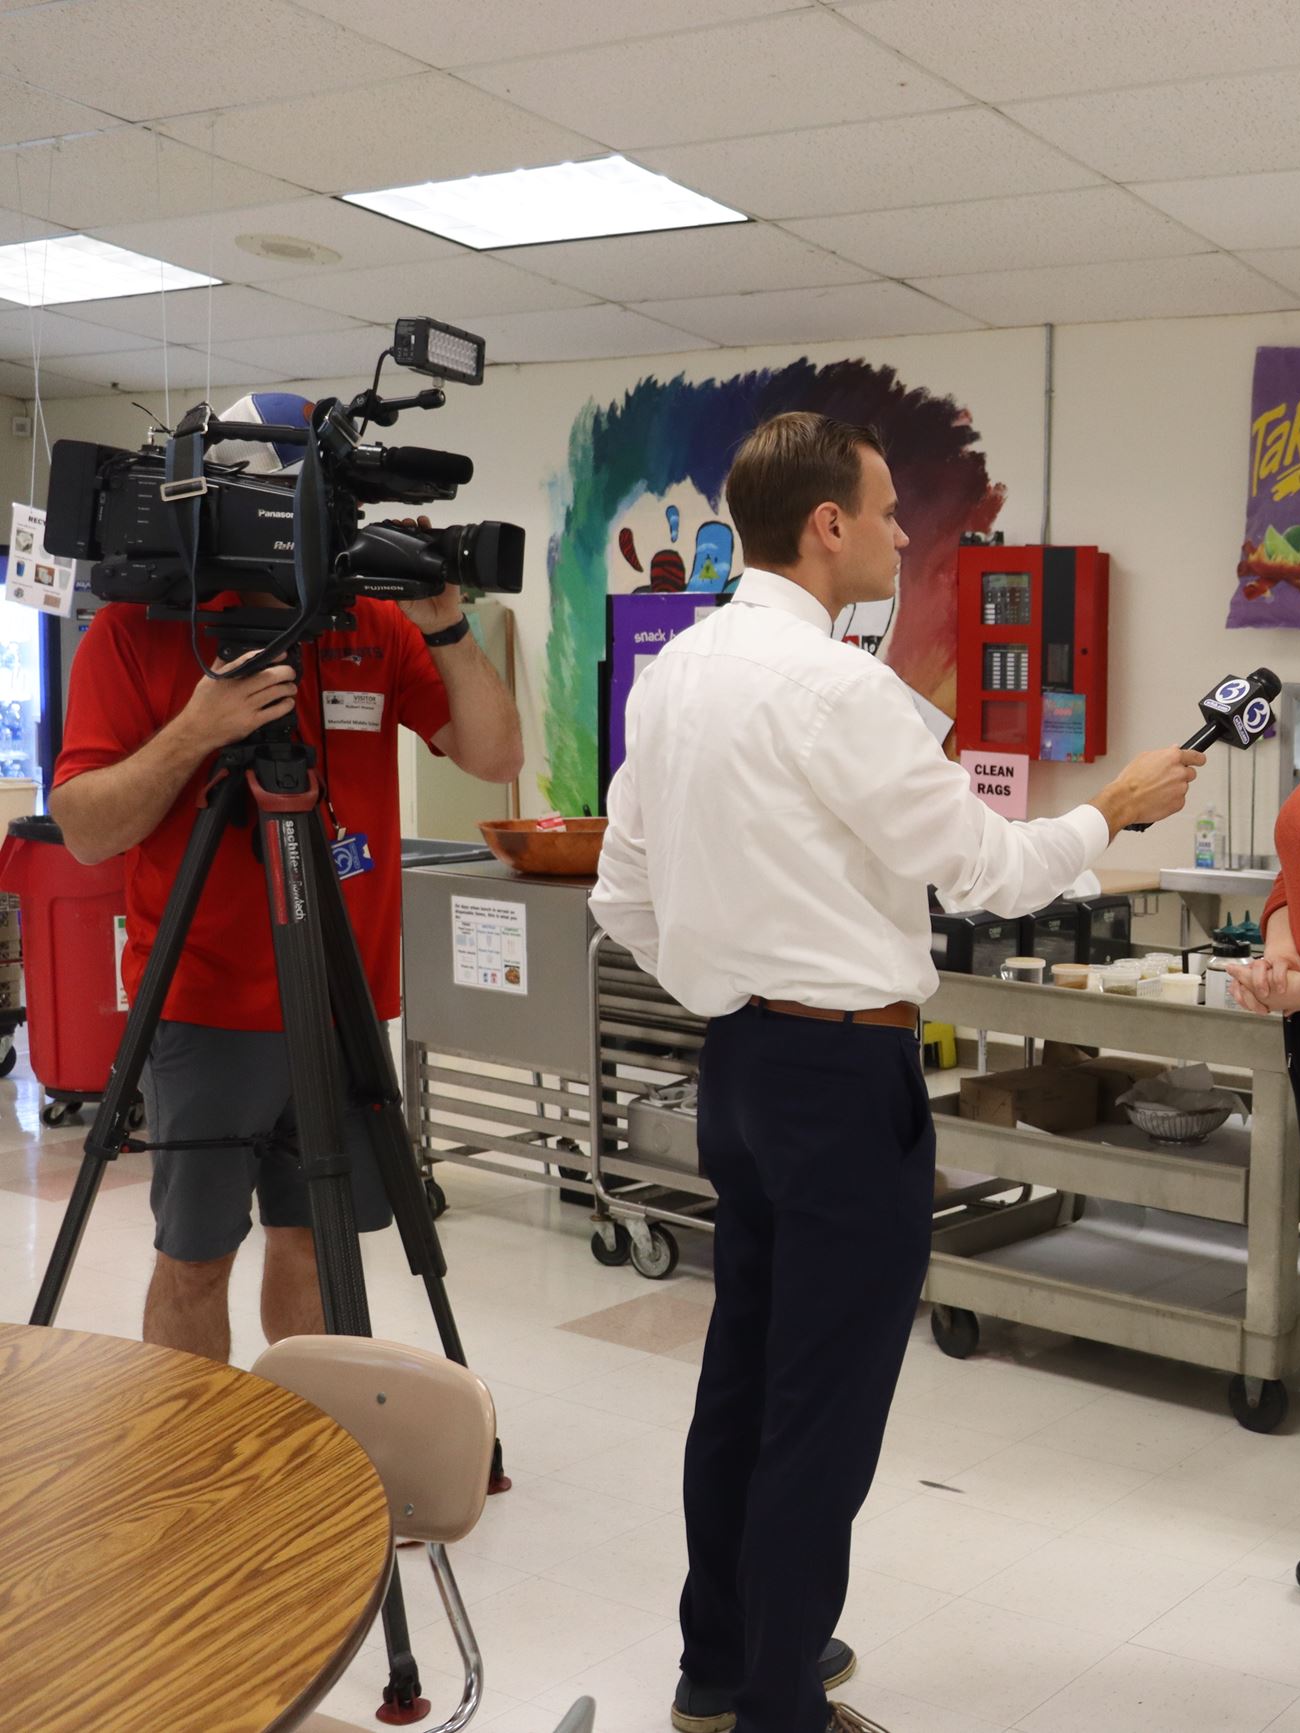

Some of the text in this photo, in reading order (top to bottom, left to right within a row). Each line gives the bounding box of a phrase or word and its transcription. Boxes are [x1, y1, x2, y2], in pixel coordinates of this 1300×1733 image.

[28, 515, 47, 527] RECY
[634, 628, 666, 644] snack
[974, 764, 1014, 778] CLEAN
[977, 782, 1011, 796] RAGS
